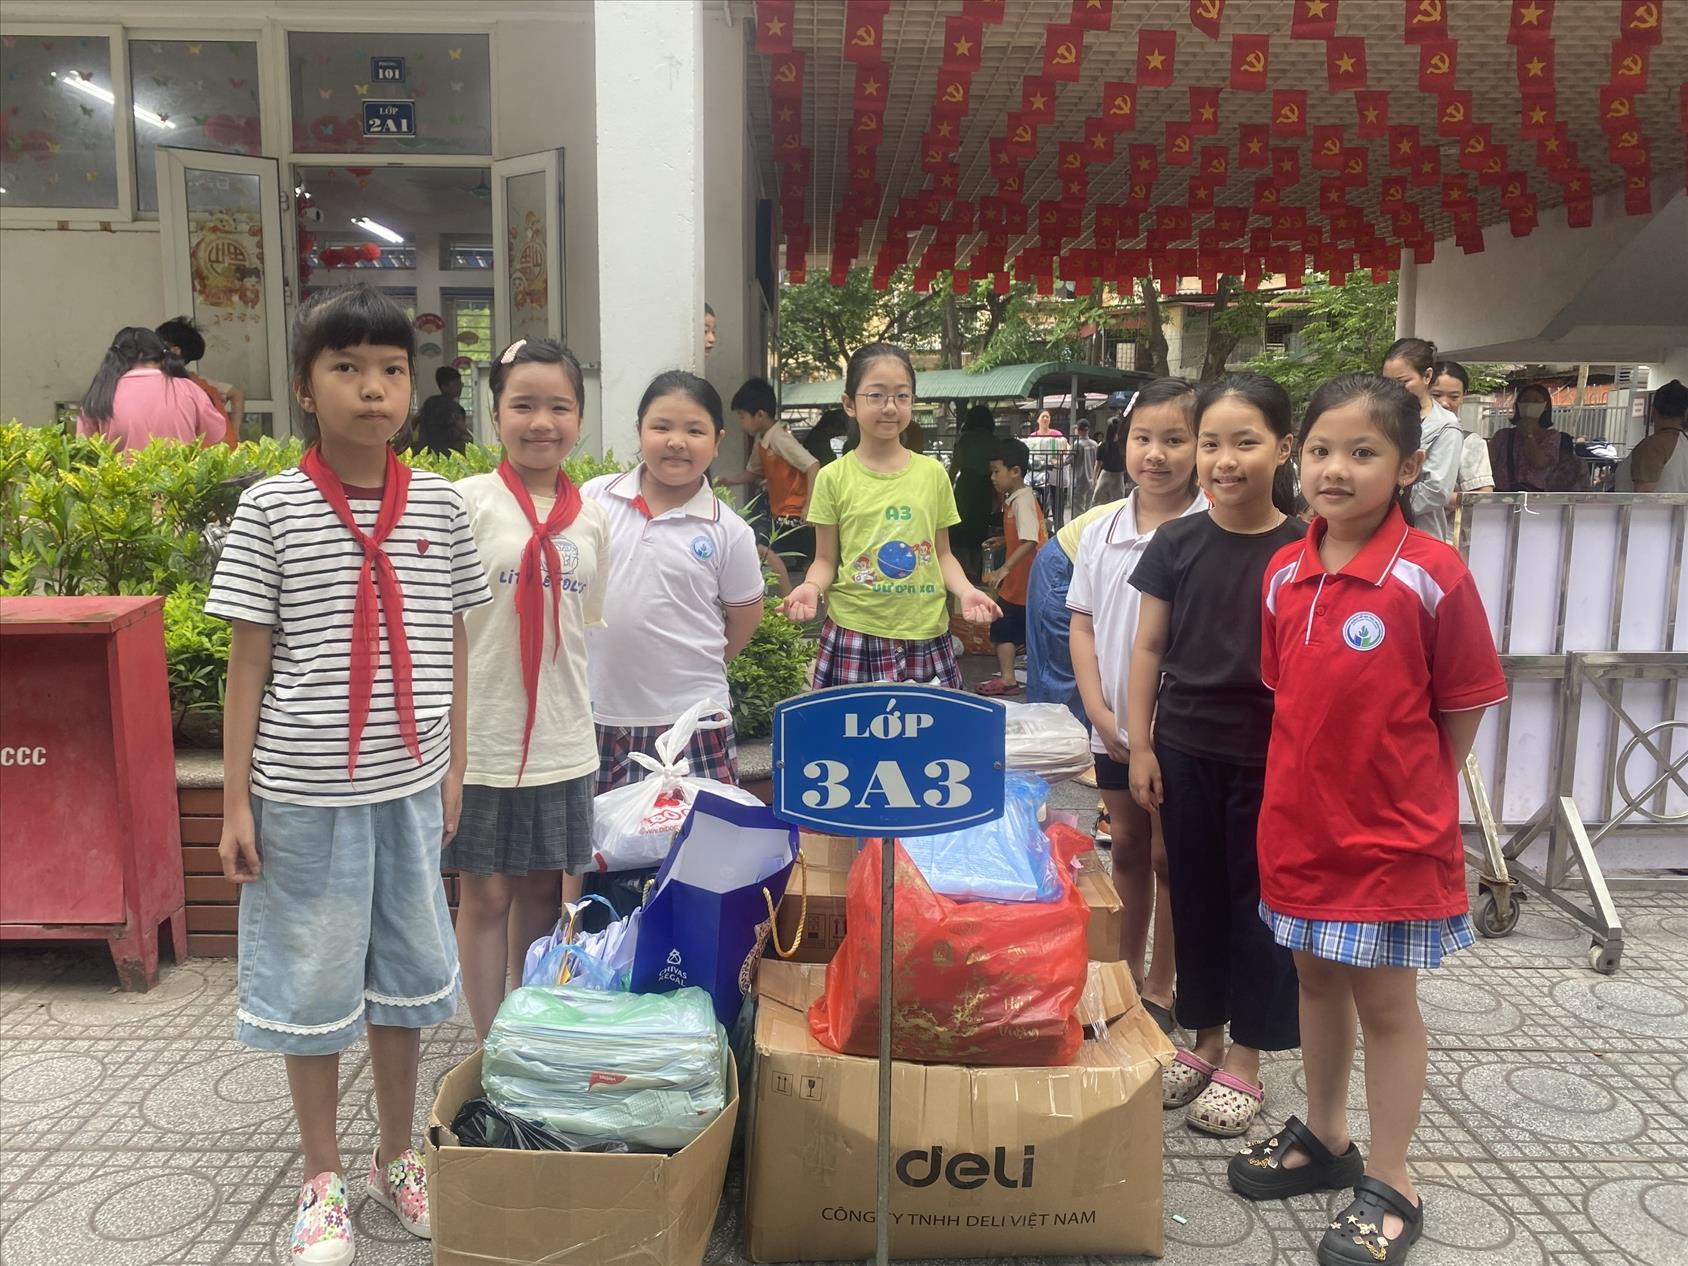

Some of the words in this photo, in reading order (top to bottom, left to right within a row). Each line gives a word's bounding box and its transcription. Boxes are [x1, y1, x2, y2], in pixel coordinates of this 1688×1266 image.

[379, 69, 400, 79] 101
[368, 118, 408, 132] 2A1
[885, 505, 912, 520] A3
[842, 698, 934, 740] LỚP
[801, 758, 973, 810] 3A3
[658, 965, 688, 980] CHIVAS
[658, 973, 686, 987] REGAL
[895, 1144, 1035, 1190] deli
[821, 1206, 876, 1224] CÔNG
[907, 1212, 960, 1227] TNHH
[965, 1214, 1006, 1228] DELI
[1010, 1211, 1050, 1229] VIỆT
[1053, 1210, 1097, 1226] NAM
